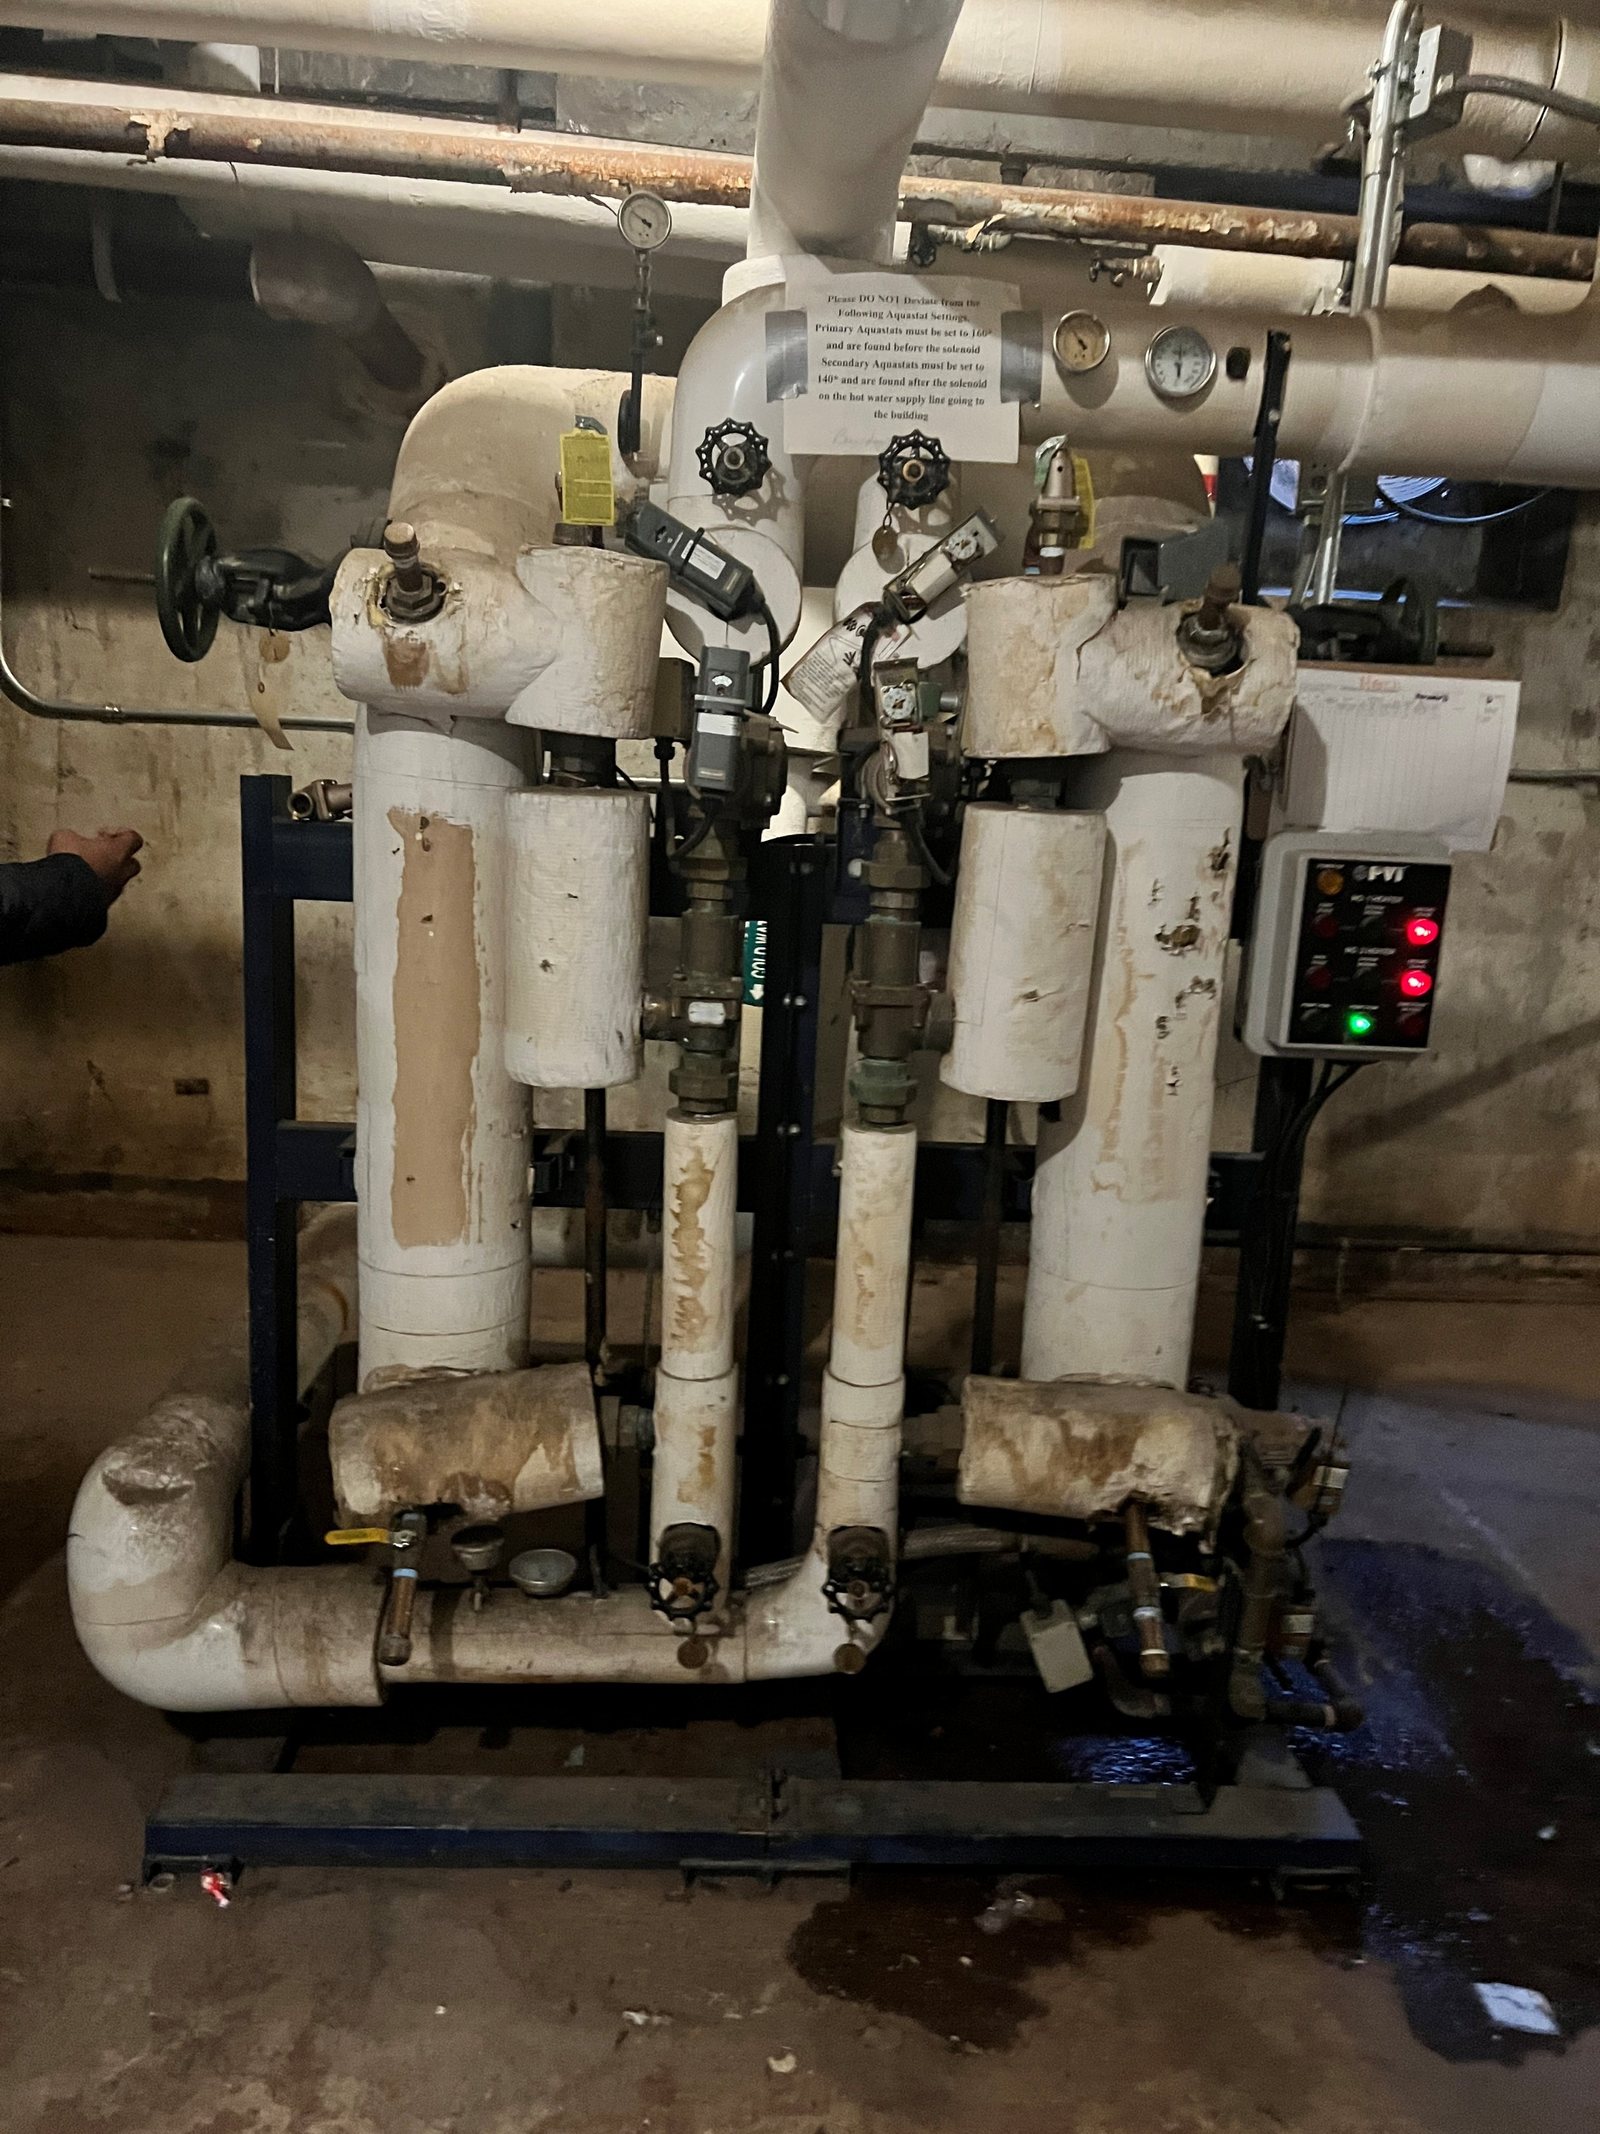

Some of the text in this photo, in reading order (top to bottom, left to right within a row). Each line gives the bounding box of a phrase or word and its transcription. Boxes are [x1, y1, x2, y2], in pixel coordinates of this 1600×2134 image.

[828, 294, 980, 307] Please DO NOT Deviate from the
[838, 308, 884, 319] Following
[886, 310, 928, 321] Aquastat
[815, 323, 853, 334] Primary
[857, 325, 902, 336] Aquastats
[905, 327, 928, 336] must
[930, 327, 941, 336] be
[944, 329, 956, 337] set
[960, 328, 969, 337] to
[826, 341, 980, 354] and are found before the solenoid
[821, 357, 984, 371] Secondary Aquastats must be set to
[841, 376, 859, 385] and
[878, 376, 905, 386] found
[908, 377, 930, 387] after
[932, 378, 947, 387] the
[949, 378, 987, 388] solenoid
[818, 392, 984, 407] on the hot water supply line going to
[874, 410, 928, 421] the building
